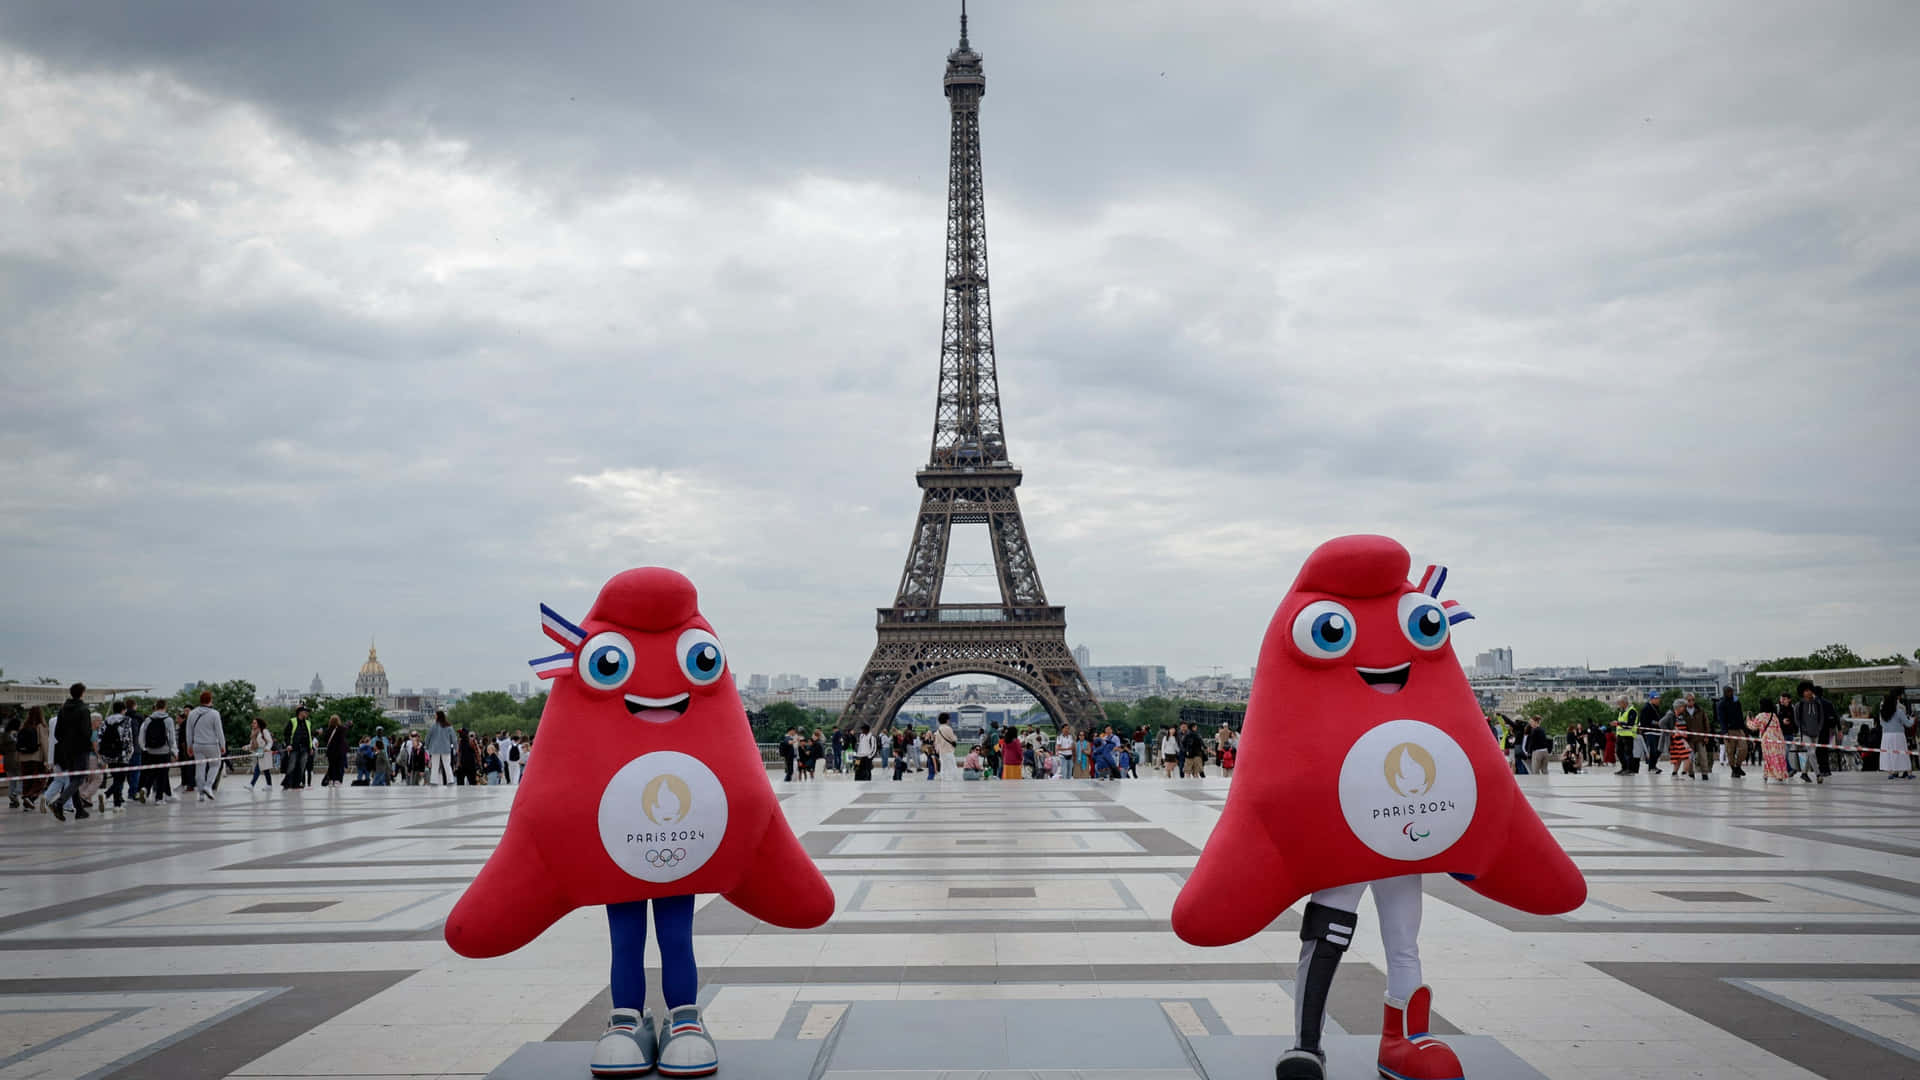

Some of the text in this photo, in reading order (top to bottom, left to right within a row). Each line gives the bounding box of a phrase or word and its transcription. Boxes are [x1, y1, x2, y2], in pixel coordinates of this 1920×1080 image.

[1373, 800, 1455, 819] PARIS 2024
[627, 830, 705, 843] PARIS 2024
